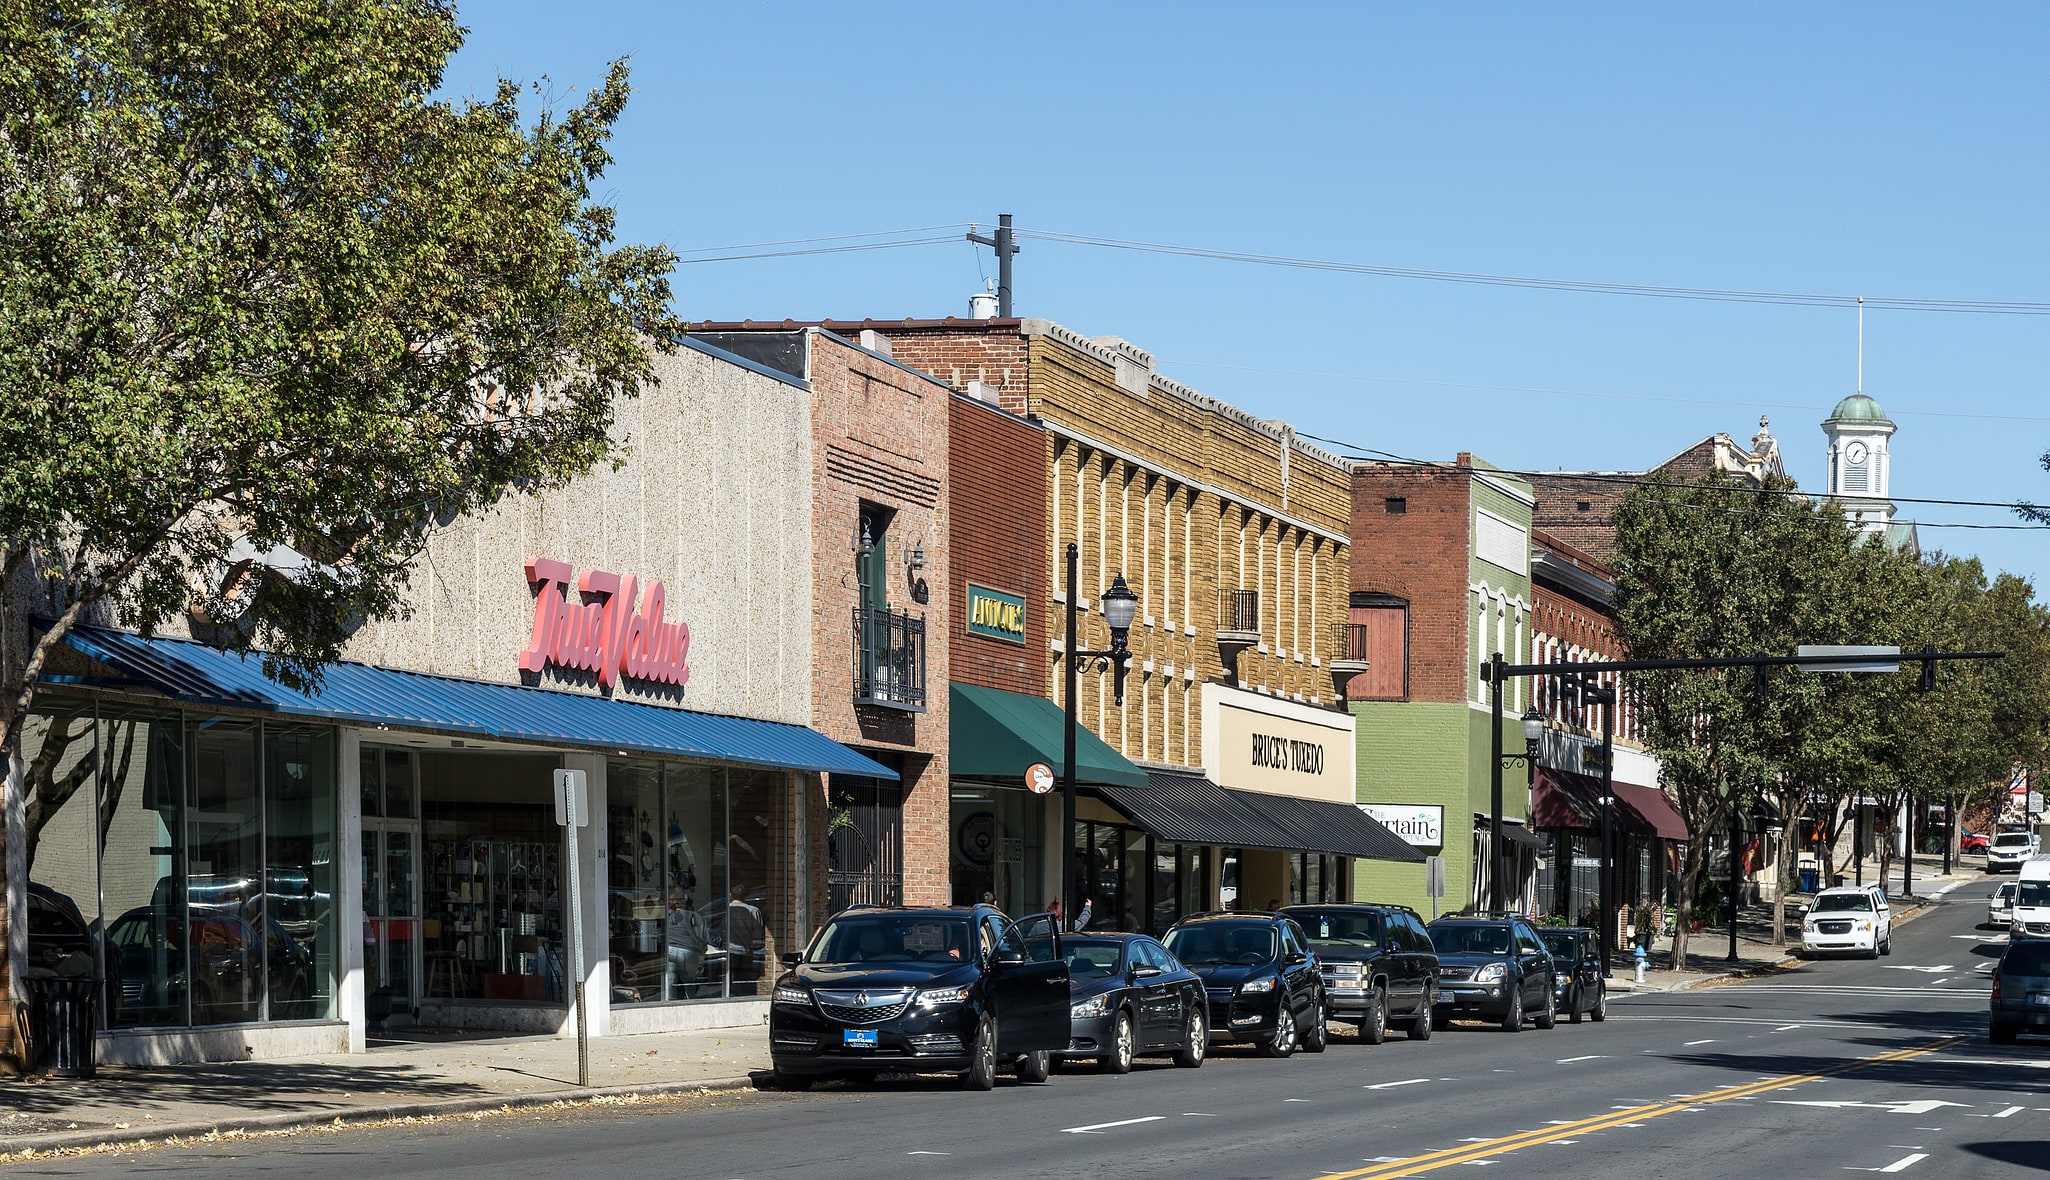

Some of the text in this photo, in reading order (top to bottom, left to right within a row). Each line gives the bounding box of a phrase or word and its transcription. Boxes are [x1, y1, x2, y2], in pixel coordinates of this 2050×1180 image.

[519, 557, 690, 688] True Value
[971, 595, 1024, 633] ANTIQUES
[1252, 733, 1324, 775] BRUCE'S TUXEDO
[1362, 808, 1438, 840] rtain
